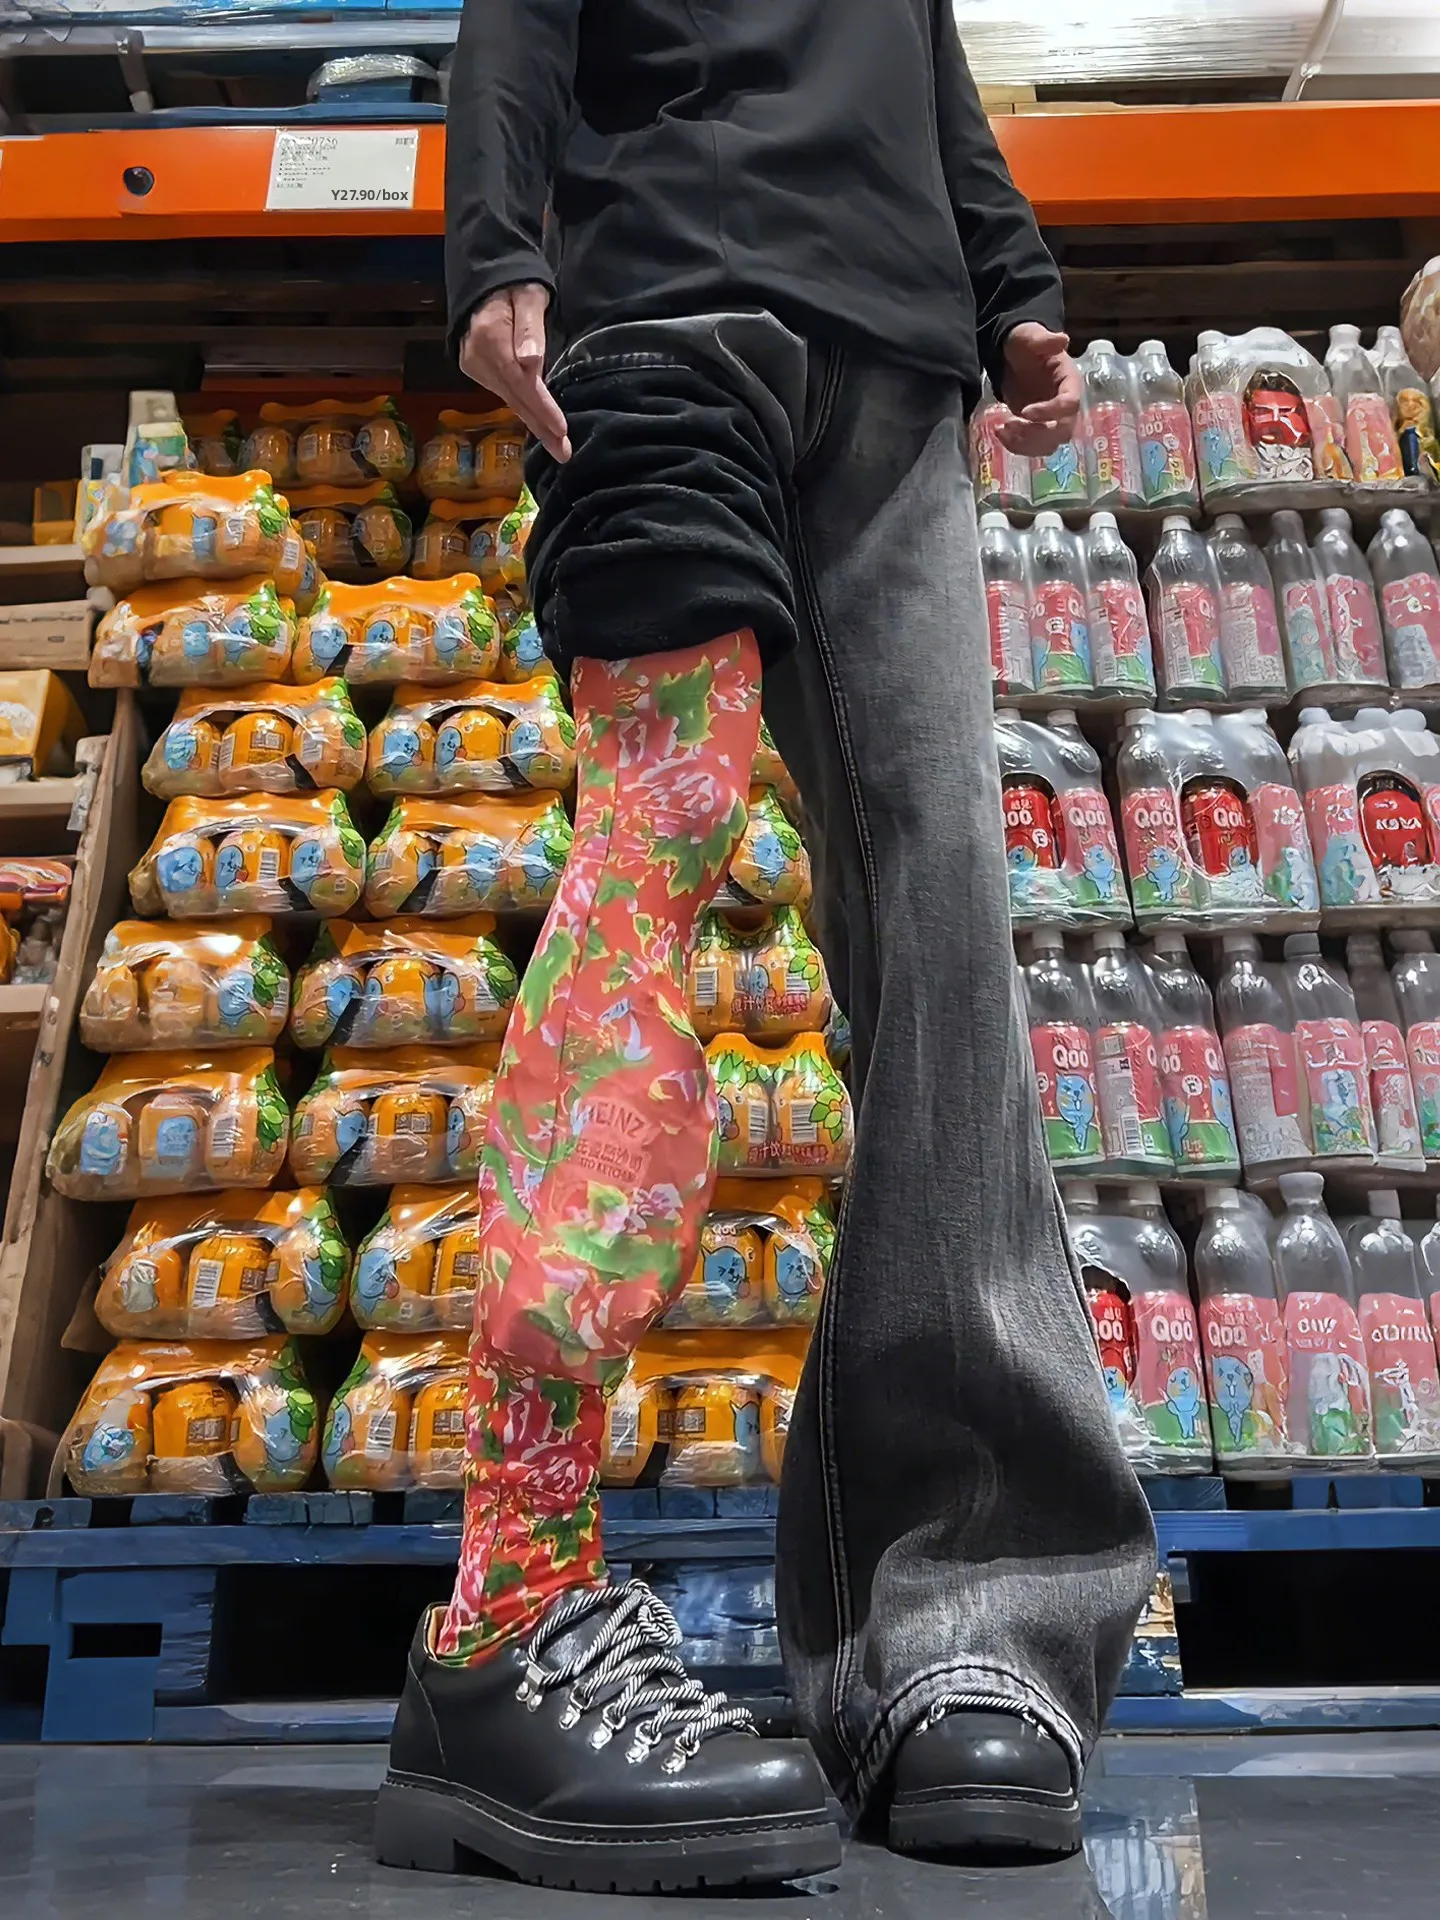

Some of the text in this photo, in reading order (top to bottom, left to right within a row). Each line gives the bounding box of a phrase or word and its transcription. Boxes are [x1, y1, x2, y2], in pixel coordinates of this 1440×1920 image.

[331, 189, 409, 201] Y27.90/box
[1069, 807, 1106, 829] Qoo
[1134, 807, 1175, 829] Qoo
[1052, 1044, 1089, 1070] Qoo
[1160, 1055, 1183, 1074] oo
[1098, 1319, 1124, 1341] oo
[1151, 1314, 1194, 1342] Qoo
